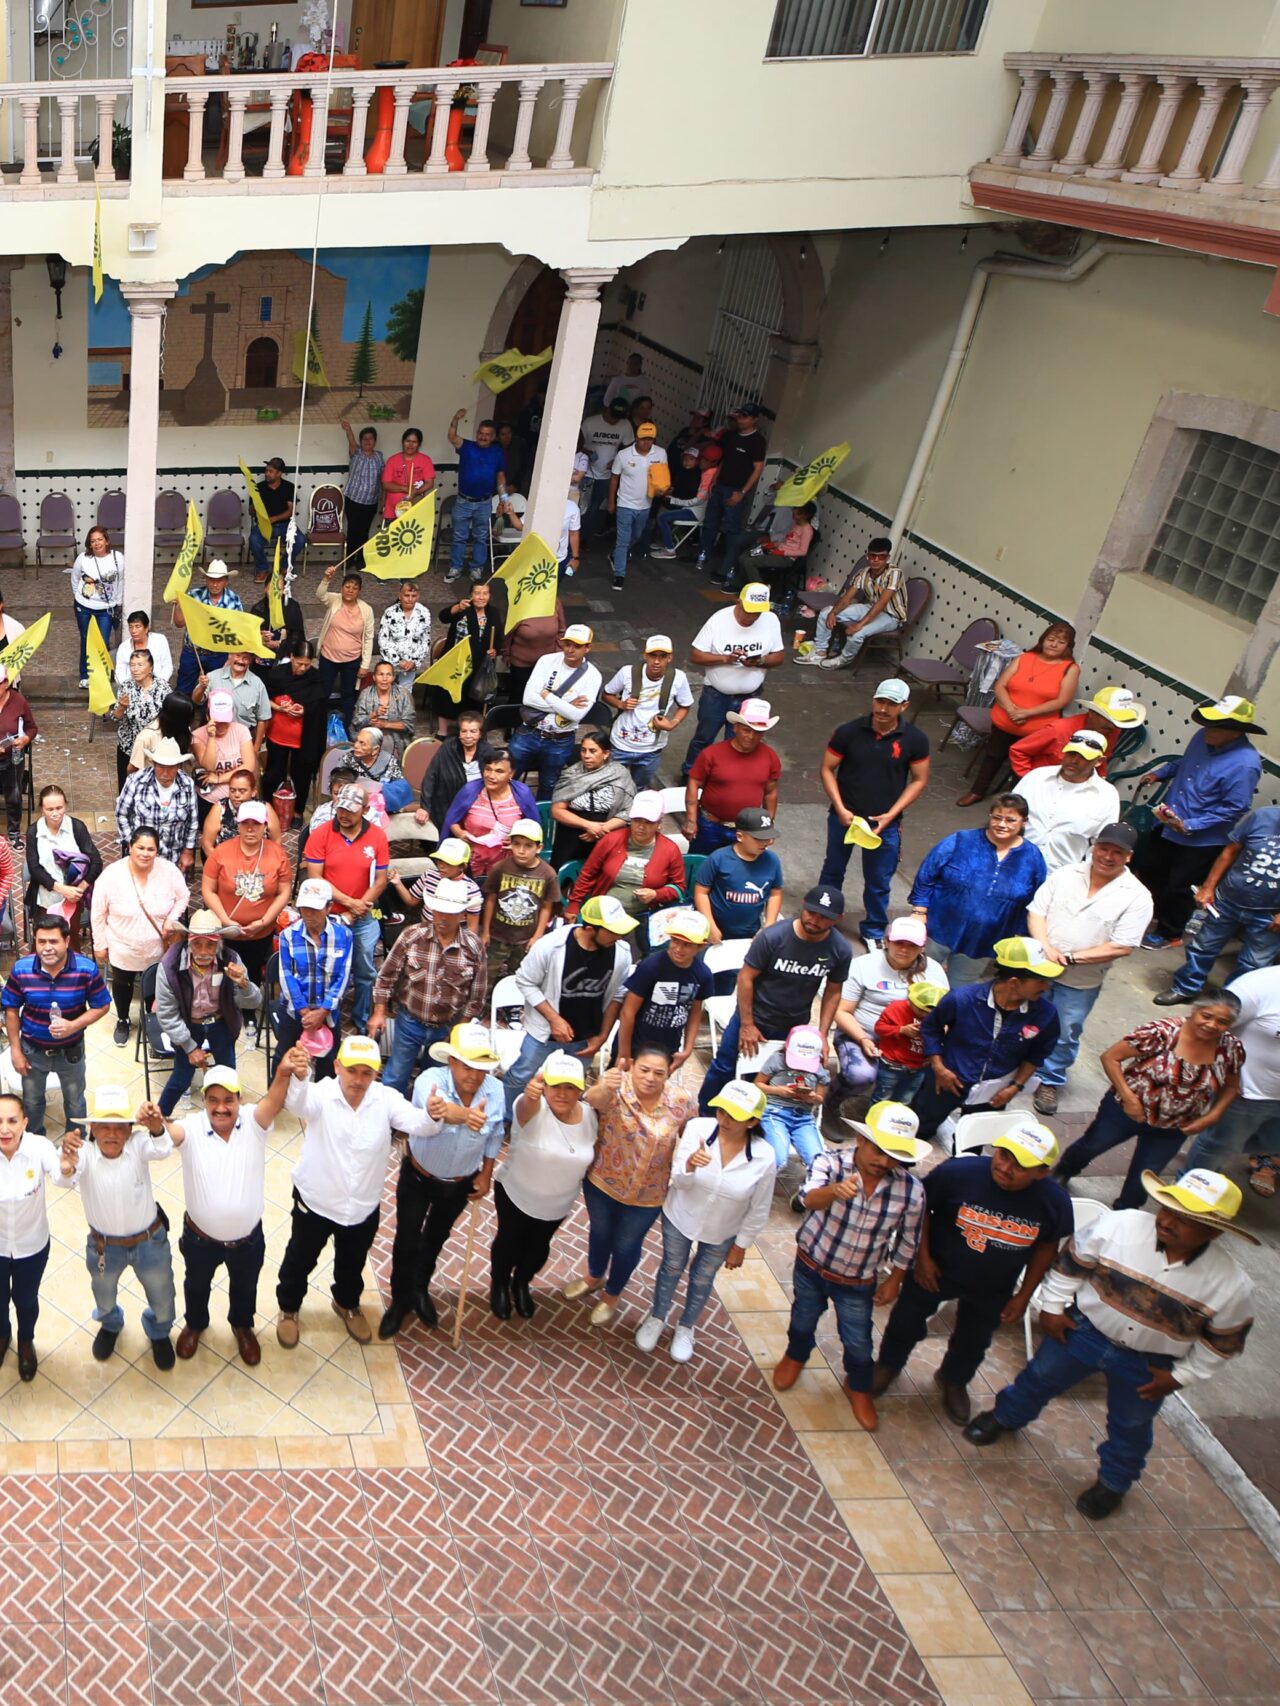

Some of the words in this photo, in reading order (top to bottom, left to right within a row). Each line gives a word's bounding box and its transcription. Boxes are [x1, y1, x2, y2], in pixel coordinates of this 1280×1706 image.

[592, 432, 620, 440] Araceli
[723, 642, 763, 654] Araceli
[725, 889, 761, 905] PUMA
[774, 957, 830, 978] NikeAir
[957, 1206, 1040, 1240] BISON
